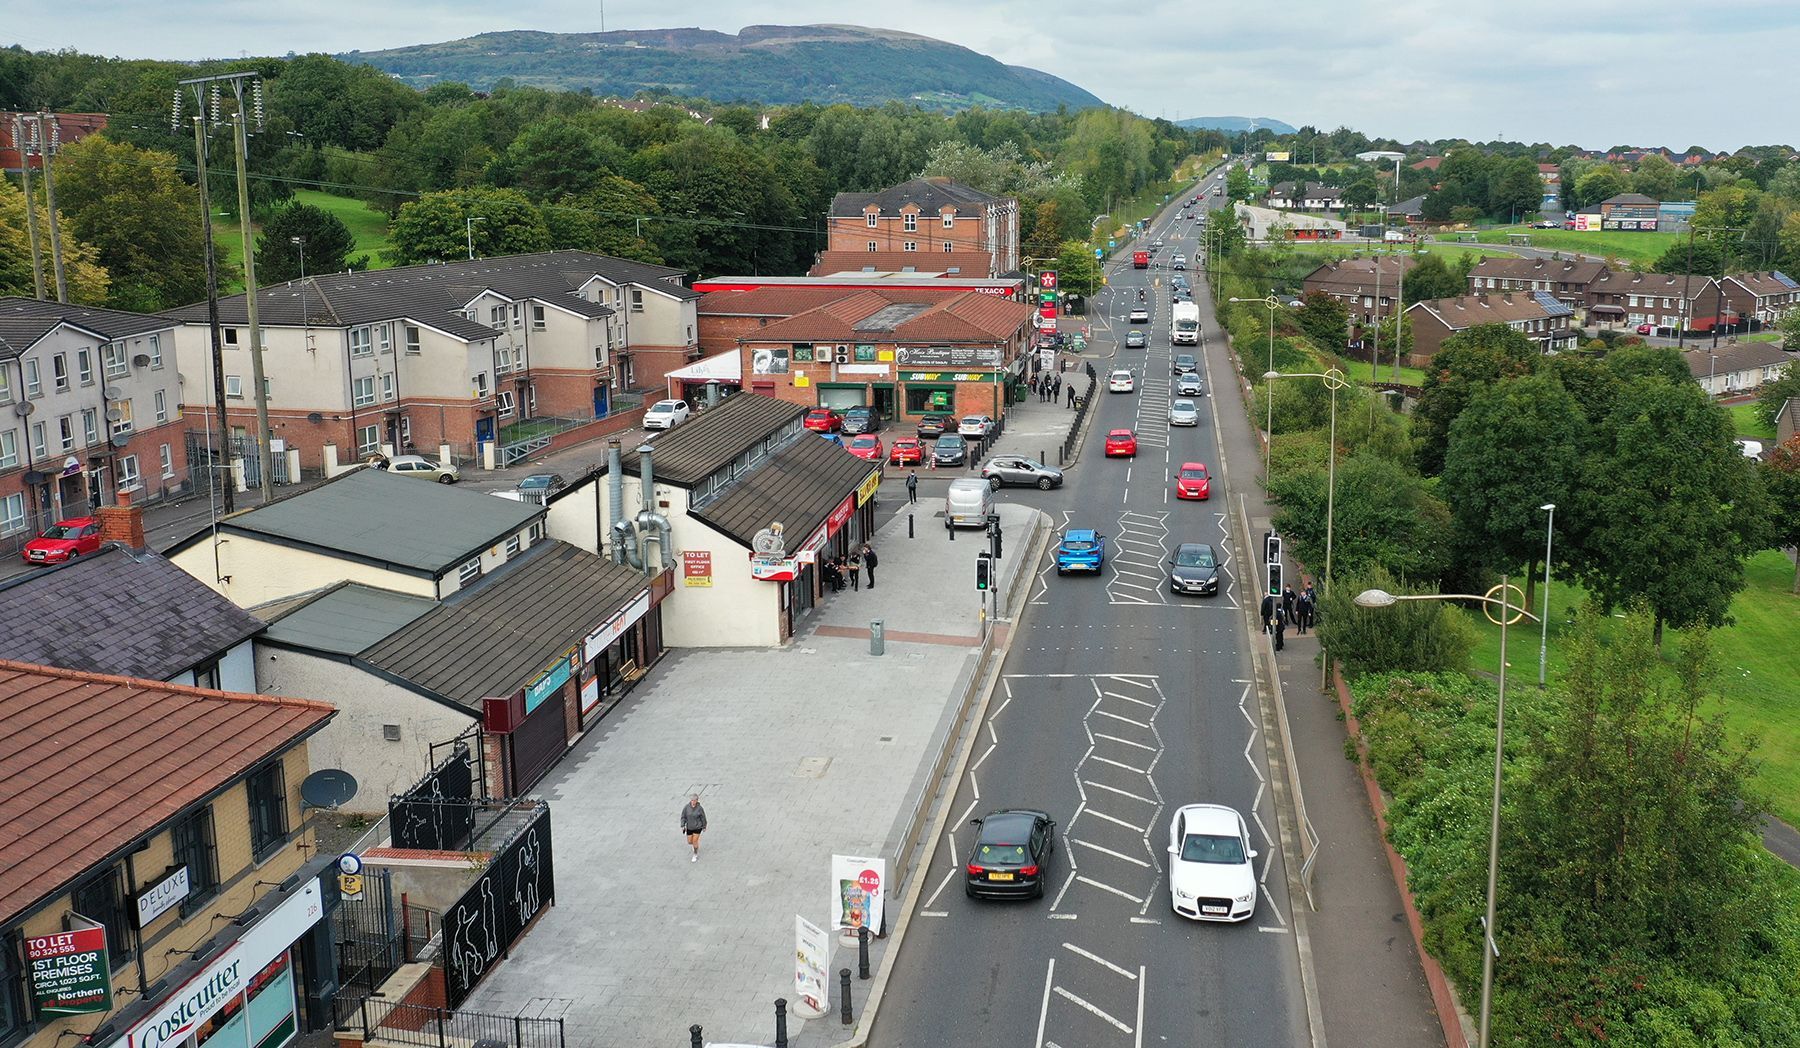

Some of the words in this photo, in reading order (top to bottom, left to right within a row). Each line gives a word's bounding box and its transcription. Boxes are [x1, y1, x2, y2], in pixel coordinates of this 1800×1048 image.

[140, 871, 185, 911] DELUXE
[307, 904, 318, 917] 226
[28, 938, 46, 950] TO
[50, 934, 73, 947] LET
[43, 947, 58, 956] 324
[60, 945, 75, 953] 555
[32, 958, 52, 970] 1ST
[56, 952, 97, 967] FLOOR
[33, 964, 93, 981] PREMISES
[35, 981, 58, 989] CIRCA
[57, 988, 104, 1000] Northern
[59, 995, 104, 1007] Property
[200, 1001, 216, 1017] Proud
[222, 991, 228, 1000] be
[229, 981, 240, 997] local
[142, 959, 240, 1048] Costcutter
